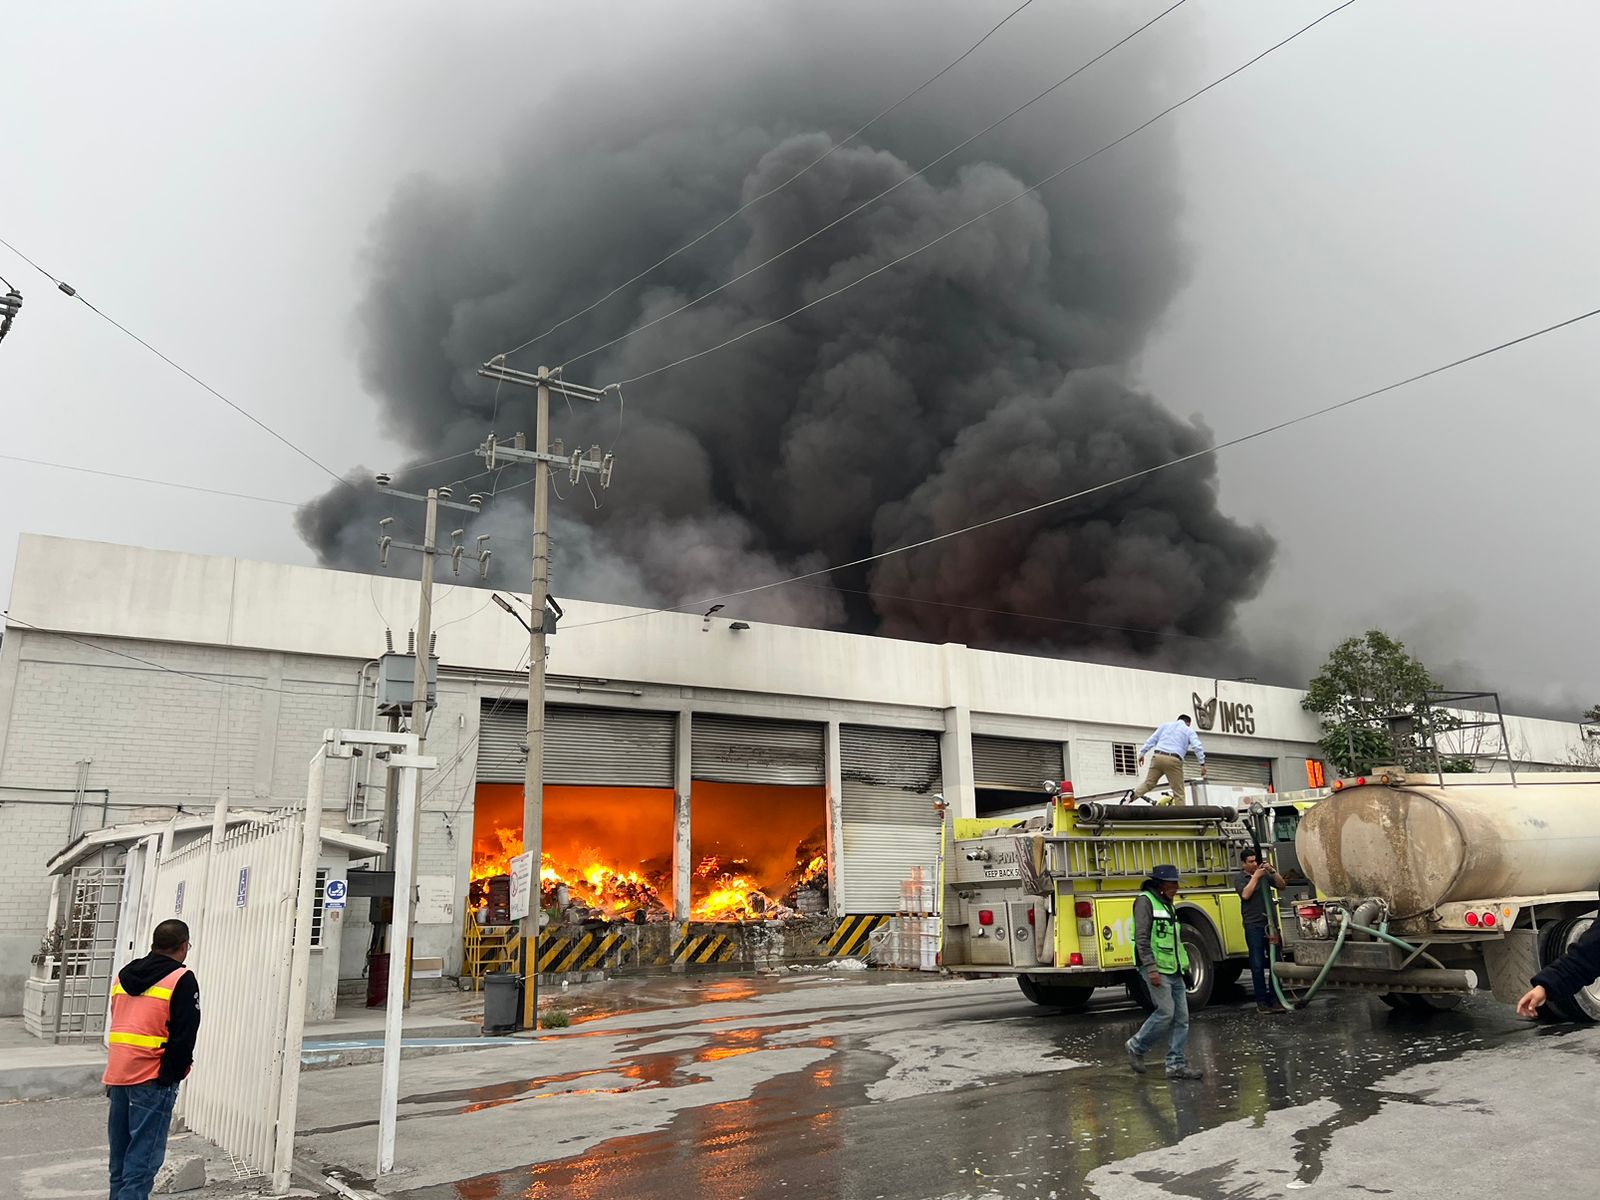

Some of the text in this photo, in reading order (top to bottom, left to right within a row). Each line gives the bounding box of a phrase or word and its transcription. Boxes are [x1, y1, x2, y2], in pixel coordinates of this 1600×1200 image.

[1219, 700, 1255, 735] IMSS
[984, 870, 998, 878] KEEP
[999, 868, 1015, 878] BACK
